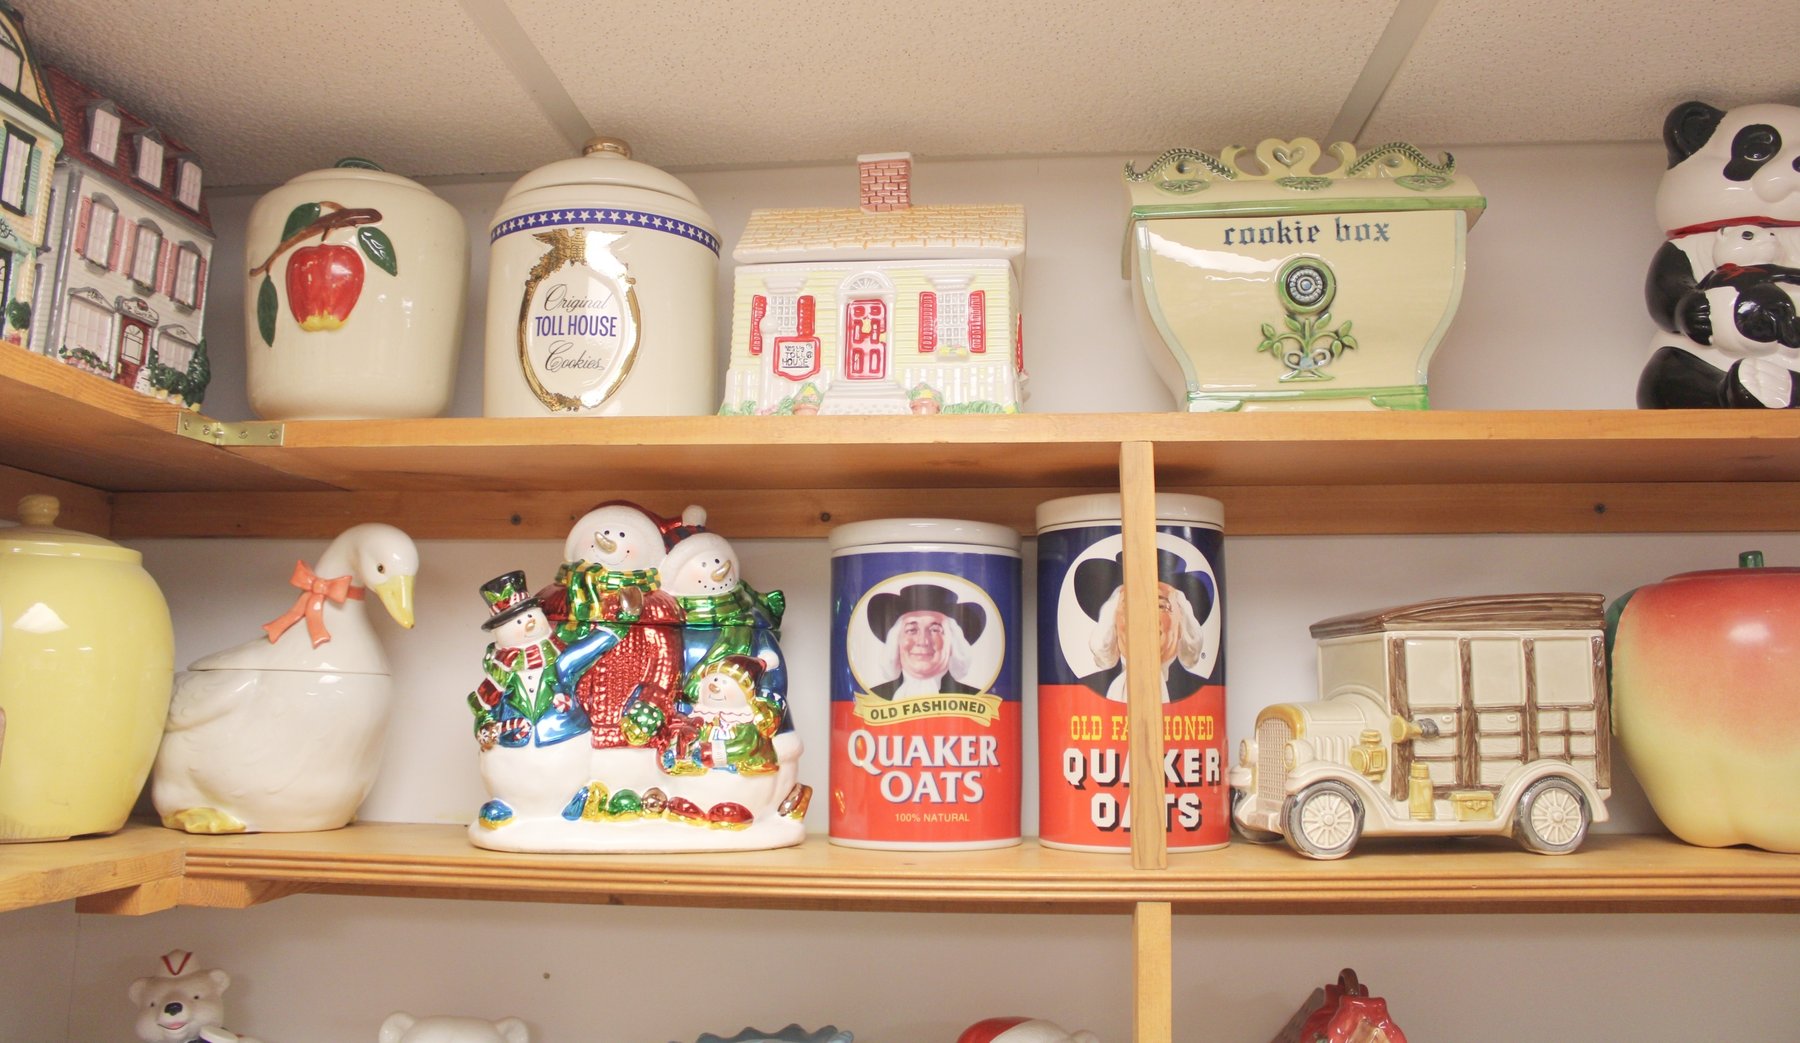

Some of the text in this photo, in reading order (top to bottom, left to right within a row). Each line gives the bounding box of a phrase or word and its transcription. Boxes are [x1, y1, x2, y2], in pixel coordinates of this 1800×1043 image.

[1223, 216, 1390, 246] cookie box
[544, 284, 613, 312] Original
[535, 315, 617, 337] TOLL HOUSE
[544, 340, 605, 373] Cookies
[870, 700, 986, 720] OLD FASHIONED
[1071, 715, 1214, 741] OLD FAIONED
[847, 729, 1000, 775] QUAKER
[880, 770, 984, 804] OATS
[895, 813, 970, 822] 100% NATURAL
